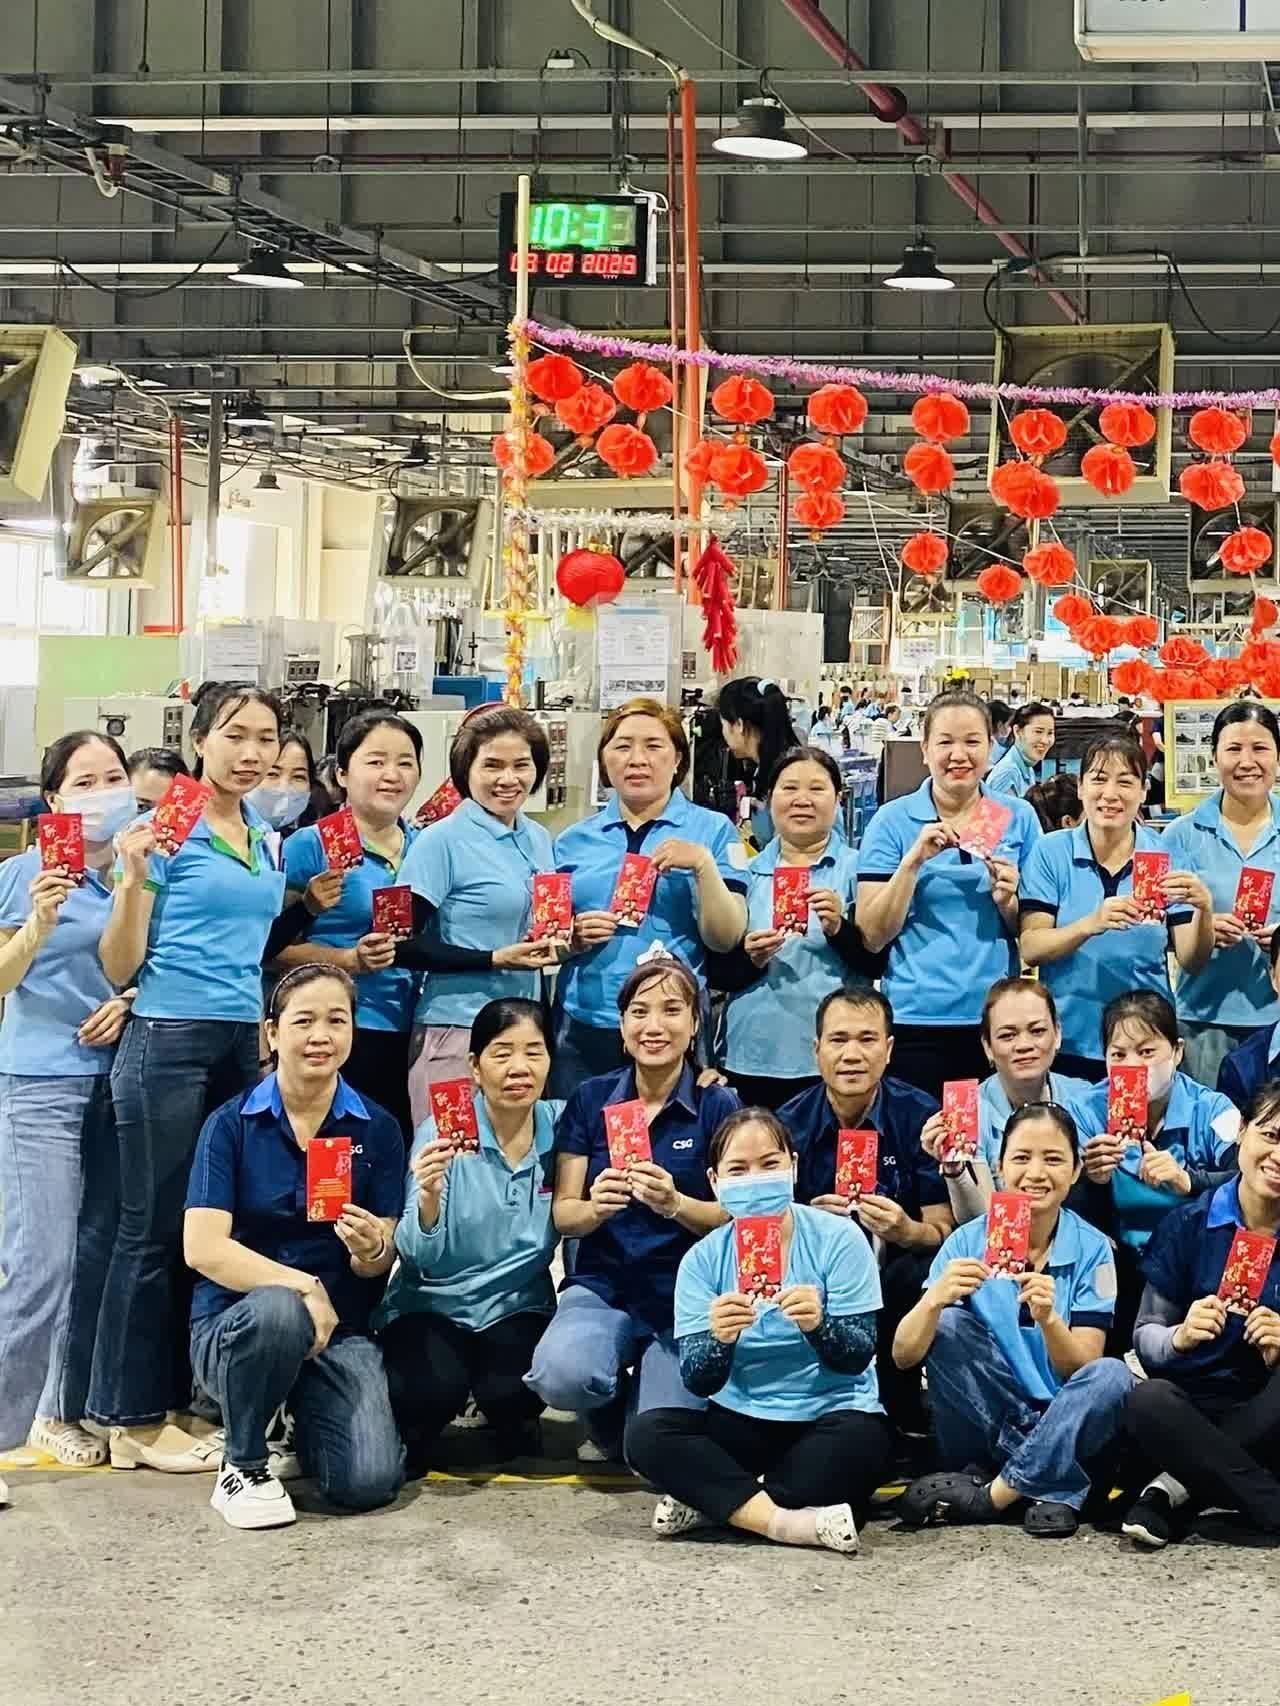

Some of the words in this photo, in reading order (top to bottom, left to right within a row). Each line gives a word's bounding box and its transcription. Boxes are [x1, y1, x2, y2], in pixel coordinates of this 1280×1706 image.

[350, 1144, 363, 1155] SG
[672, 1138, 694, 1150] CSG
[882, 1155, 896, 1166] SG
